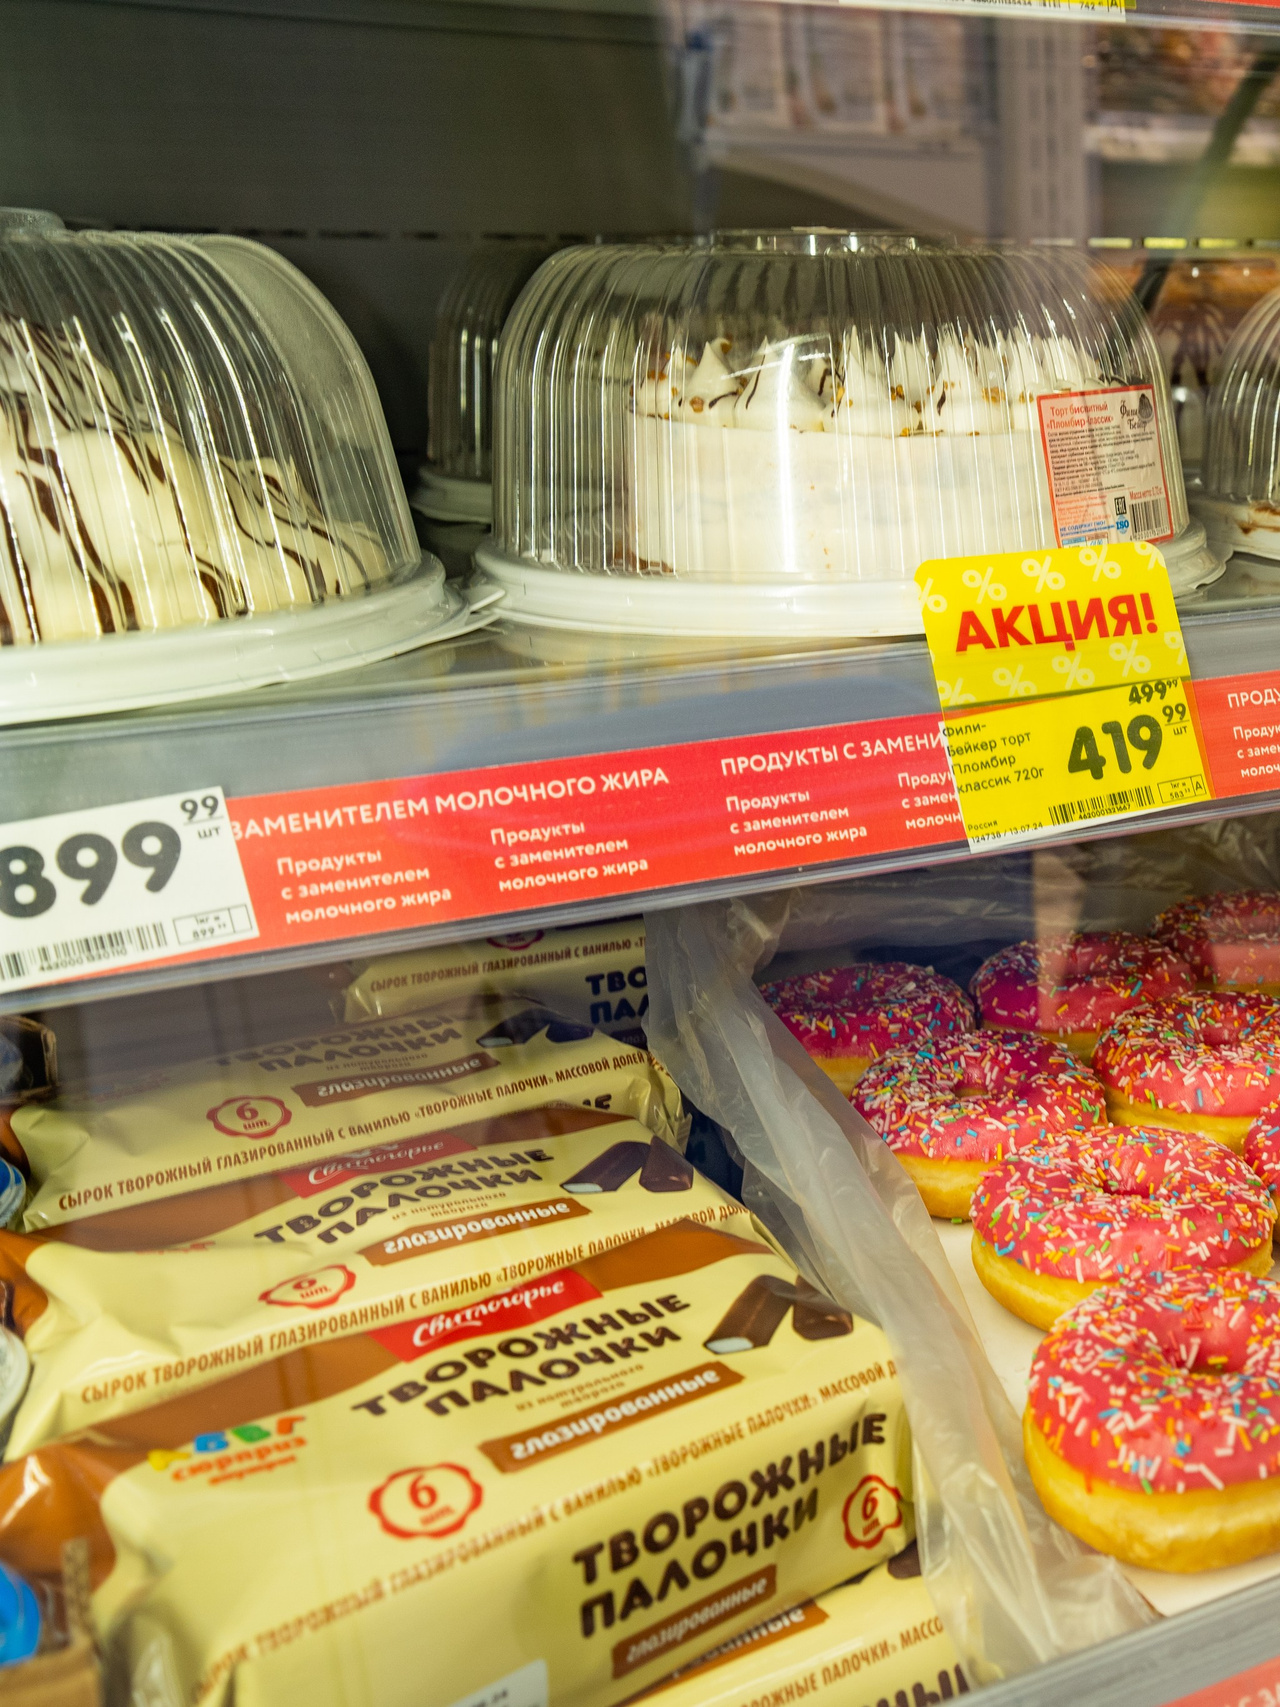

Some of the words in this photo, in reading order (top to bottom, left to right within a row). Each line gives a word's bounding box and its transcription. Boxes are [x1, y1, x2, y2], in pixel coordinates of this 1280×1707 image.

[1050, 406, 1068, 417] Торт
[1116, 520, 1130, 530] ISO
[955, 592, 1159, 653] АКЦИЯ!
[1128, 680, 1167, 705] 499
[942, 723, 987, 739] Фили-
[946, 738, 997, 758] Бейкер
[1002, 730, 1032, 749] торт
[1067, 714, 1163, 781] 419
[1162, 702, 1187, 723] 99
[1172, 725, 1188, 736] шт
[721, 748, 839, 777] ПРОДУКТЫ
[843, 743, 857, 760] С
[860, 731, 945, 759] ЗАМЕНИ
[950, 753, 1017, 776] Пломбир
[956, 774, 1012, 795] классик
[1014, 766, 1045, 783] 720г
[231, 798, 429, 840] ЗАМЕНИТЕЛЕМ
[435, 776, 596, 814] МОЛОЧНОГО
[600, 767, 669, 793] ЖИРА
[726, 790, 810, 815] Продукты
[742, 806, 849, 834] заменителем
[198, 826, 221, 839] шт
[490, 821, 586, 847] Продукты
[733, 830, 823, 857] молочного
[826, 825, 868, 843] жира
[968, 820, 998, 832] Россия
[971, 831, 1002, 844] 124738
[1009, 821, 1044, 835] 13.07.24
[0, 820, 182, 919] 899
[181, 796, 219, 821] 99
[277, 850, 382, 877] Продукты
[494, 856, 506, 869] с
[510, 838, 629, 867] заменителем
[281, 886, 293, 900] с
[298, 868, 430, 898] заменителем
[498, 866, 599, 893] молочного
[602, 858, 649, 876] жира
[286, 897, 397, 925] молочного
[400, 888, 452, 907] жира
[370, 975, 408, 993] СЫРОК
[411, 960, 479, 986] ТВОРОЖНЫЙ
[482, 947, 572, 973] ГЛАЗИРОВАННЫЙ
[582, 938, 632, 957] ВАНИЛЬЮ
[259, 1027, 463, 1073] ПАЛОЧКИ
[317, 1057, 482, 1098] глазированные
[236, 1102, 259, 1122] 6
[59, 1179, 113, 1212] СЫРОК
[116, 1157, 213, 1195] ТВОРОЖНЫЙ
[217, 1127, 335, 1171] ГЛАЗИРОВАННЫЙ
[348, 1110, 411, 1140] ВАНИЛЬЮ
[414, 1088, 495, 1120] «ТВОРОЖНЫЕ
[496, 1074, 554, 1100] ПАЛОЧКИ»
[555, 1058, 610, 1084] МАССОВОЙ
[612, 1050, 645, 1070] ДОЛЕЙ
[254, 1148, 555, 1245] ТВОРОЖНЫЕ
[316, 1167, 543, 1245] ПАЛОЧКИ
[383, 1200, 571, 1255] глазированные
[81, 1370, 147, 1404] СЫРОК
[153, 1338, 264, 1386] ТВОРОЖНЫЙ
[269, 1294, 405, 1352] ГЛАЗИРОВАННЫЙ
[409, 1292, 419, 1310] С
[421, 1271, 492, 1307] ВАНИЛЬЮ
[495, 1247, 585, 1282] «ТВОРОЖНЫЕ
[351, 1293, 691, 1418] ТВОРОЖНЫЕ
[424, 1326, 682, 1417] ПАЛОЧКИ
[819, 1371, 885, 1402] МАССОВОЙ
[511, 1368, 720, 1460] глазированные
[408, 1473, 438, 1510] 6
[572, 1413, 888, 1586] ТВОРОЖНЫЕ
[860, 1487, 879, 1521] 6
[580, 1488, 819, 1639] ПАЛОЧКИ
[626, 1575, 768, 1663] глазированные
